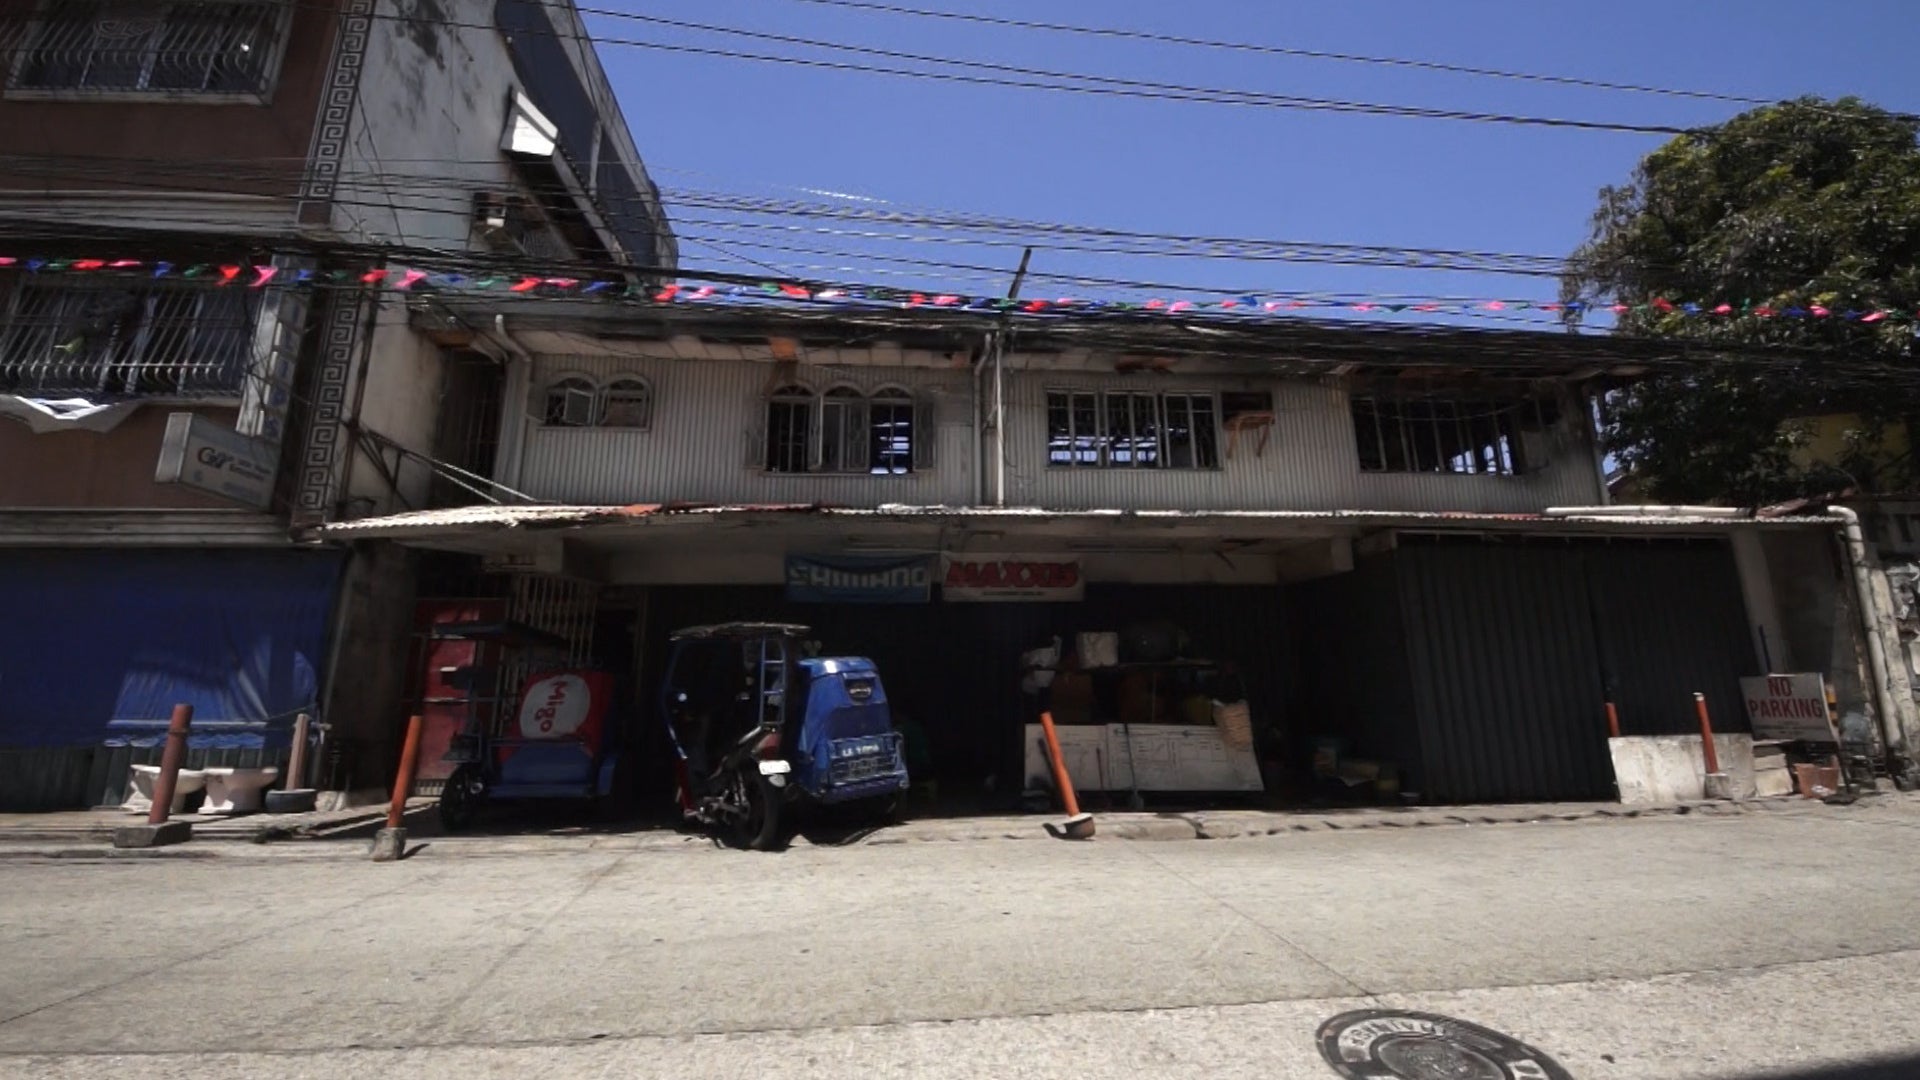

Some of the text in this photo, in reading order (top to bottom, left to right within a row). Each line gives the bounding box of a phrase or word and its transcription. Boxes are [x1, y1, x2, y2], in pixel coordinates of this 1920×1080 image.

[788, 565, 927, 588] SHIMANO
[944, 561, 1079, 588] MAXXIS
[1766, 677, 1792, 697] NO
[1748, 698, 1823, 718] PARKING
